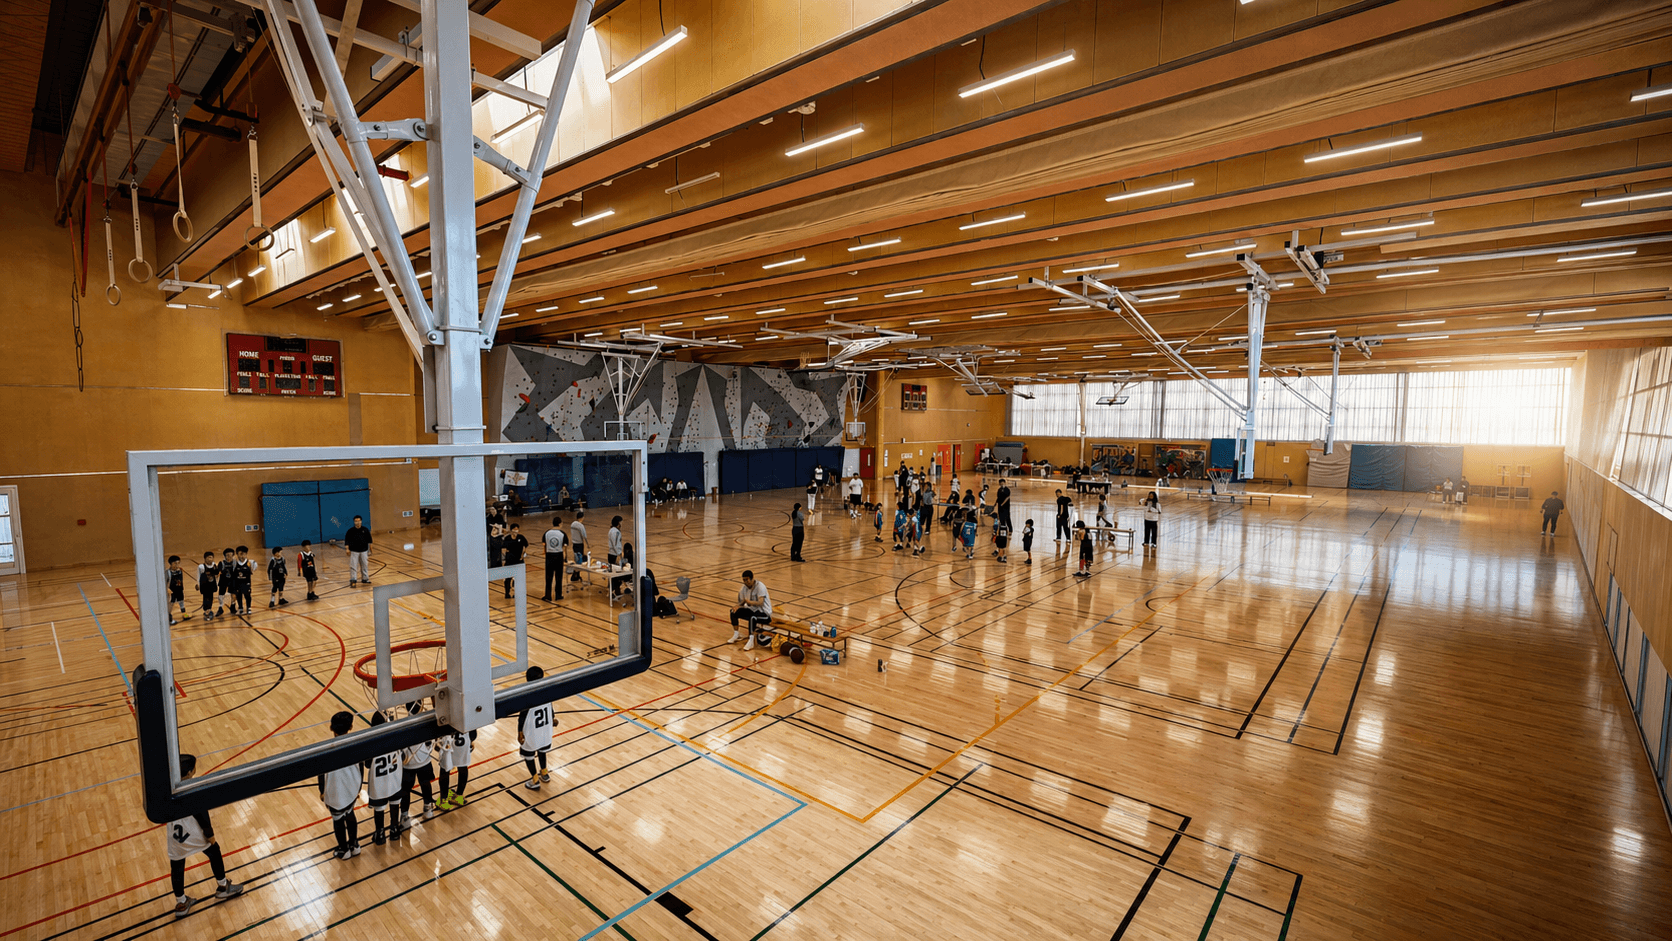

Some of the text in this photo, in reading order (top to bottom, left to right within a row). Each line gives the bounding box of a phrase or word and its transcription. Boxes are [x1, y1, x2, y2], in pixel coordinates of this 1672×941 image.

[239, 350, 259, 358] HOME
[312, 354, 333, 362] GUEST
[534, 706, 549, 729] 21
